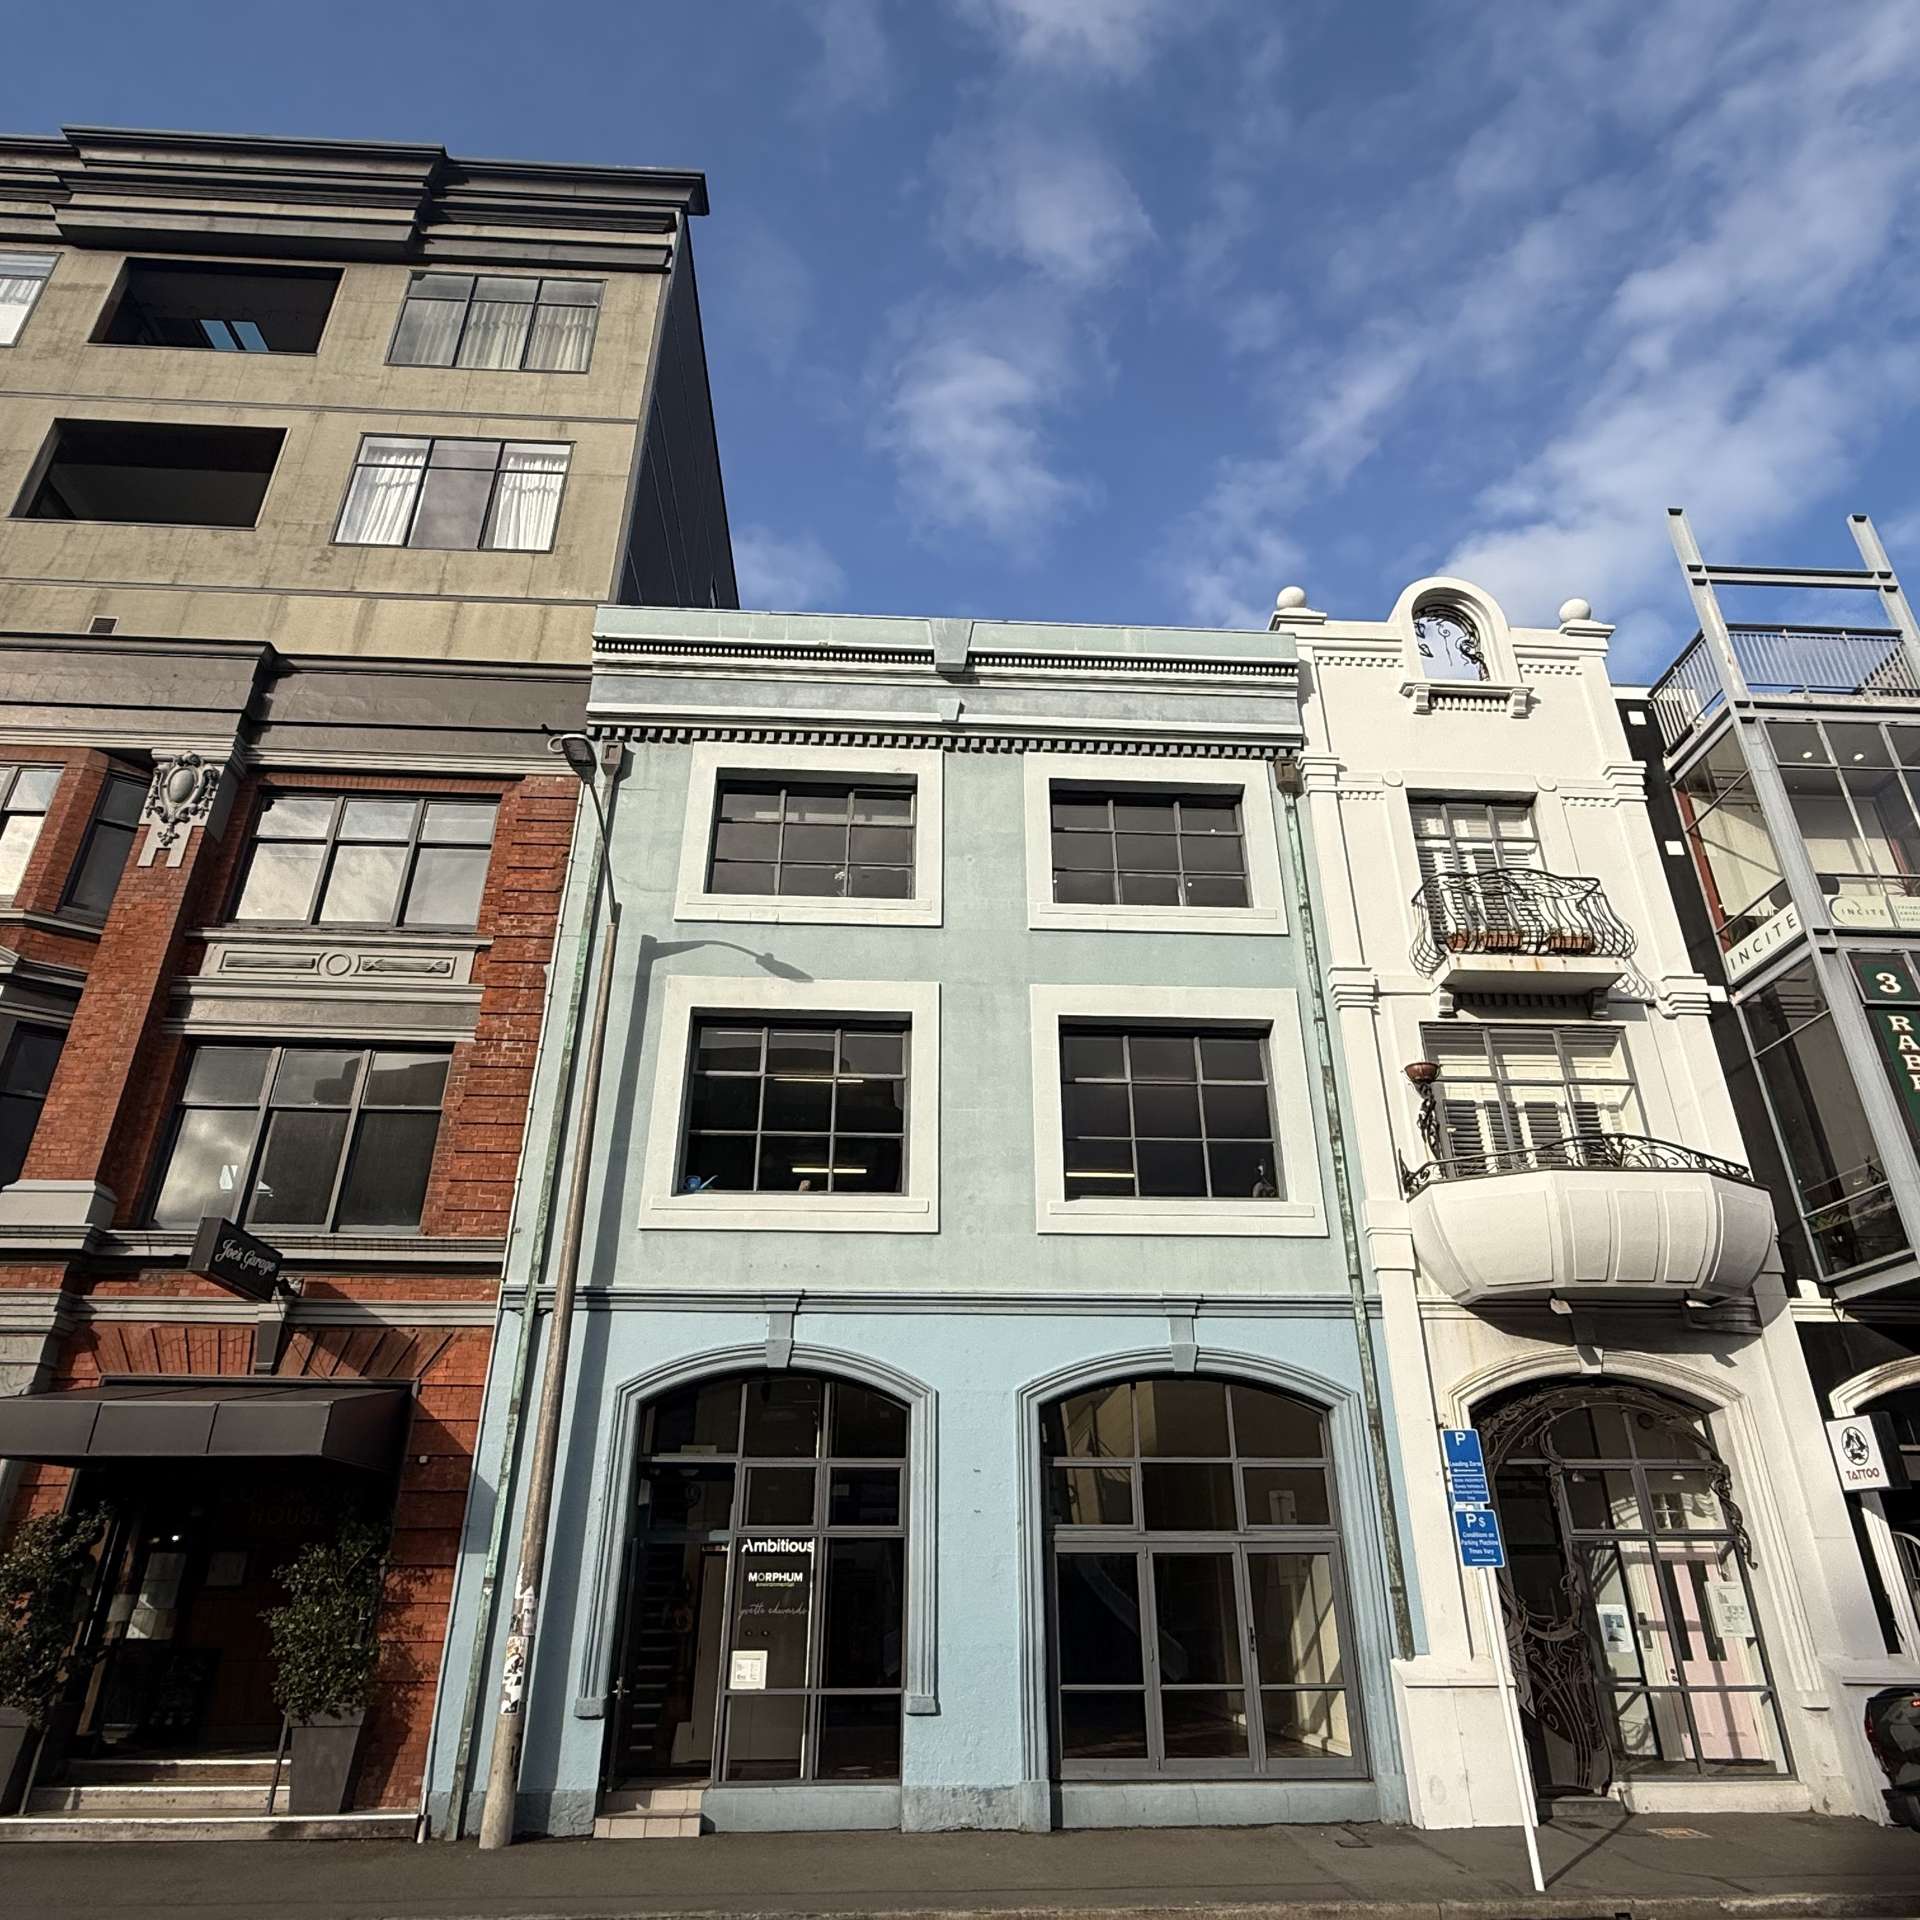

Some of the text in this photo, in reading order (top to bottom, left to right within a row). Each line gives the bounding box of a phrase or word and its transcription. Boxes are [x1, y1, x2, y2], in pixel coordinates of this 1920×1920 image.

[1841, 908, 1886, 916] INCITE
[1730, 912, 1797, 971] INCITE
[1876, 972, 1902, 993] 3
[214, 1239, 277, 1276] Joe's Garage
[1455, 1432, 1466, 1446] P
[1845, 1467, 1880, 1480] TATTOO
[741, 1538, 814, 1553] Ambitious
[748, 1572, 803, 1582] MORPHUM
